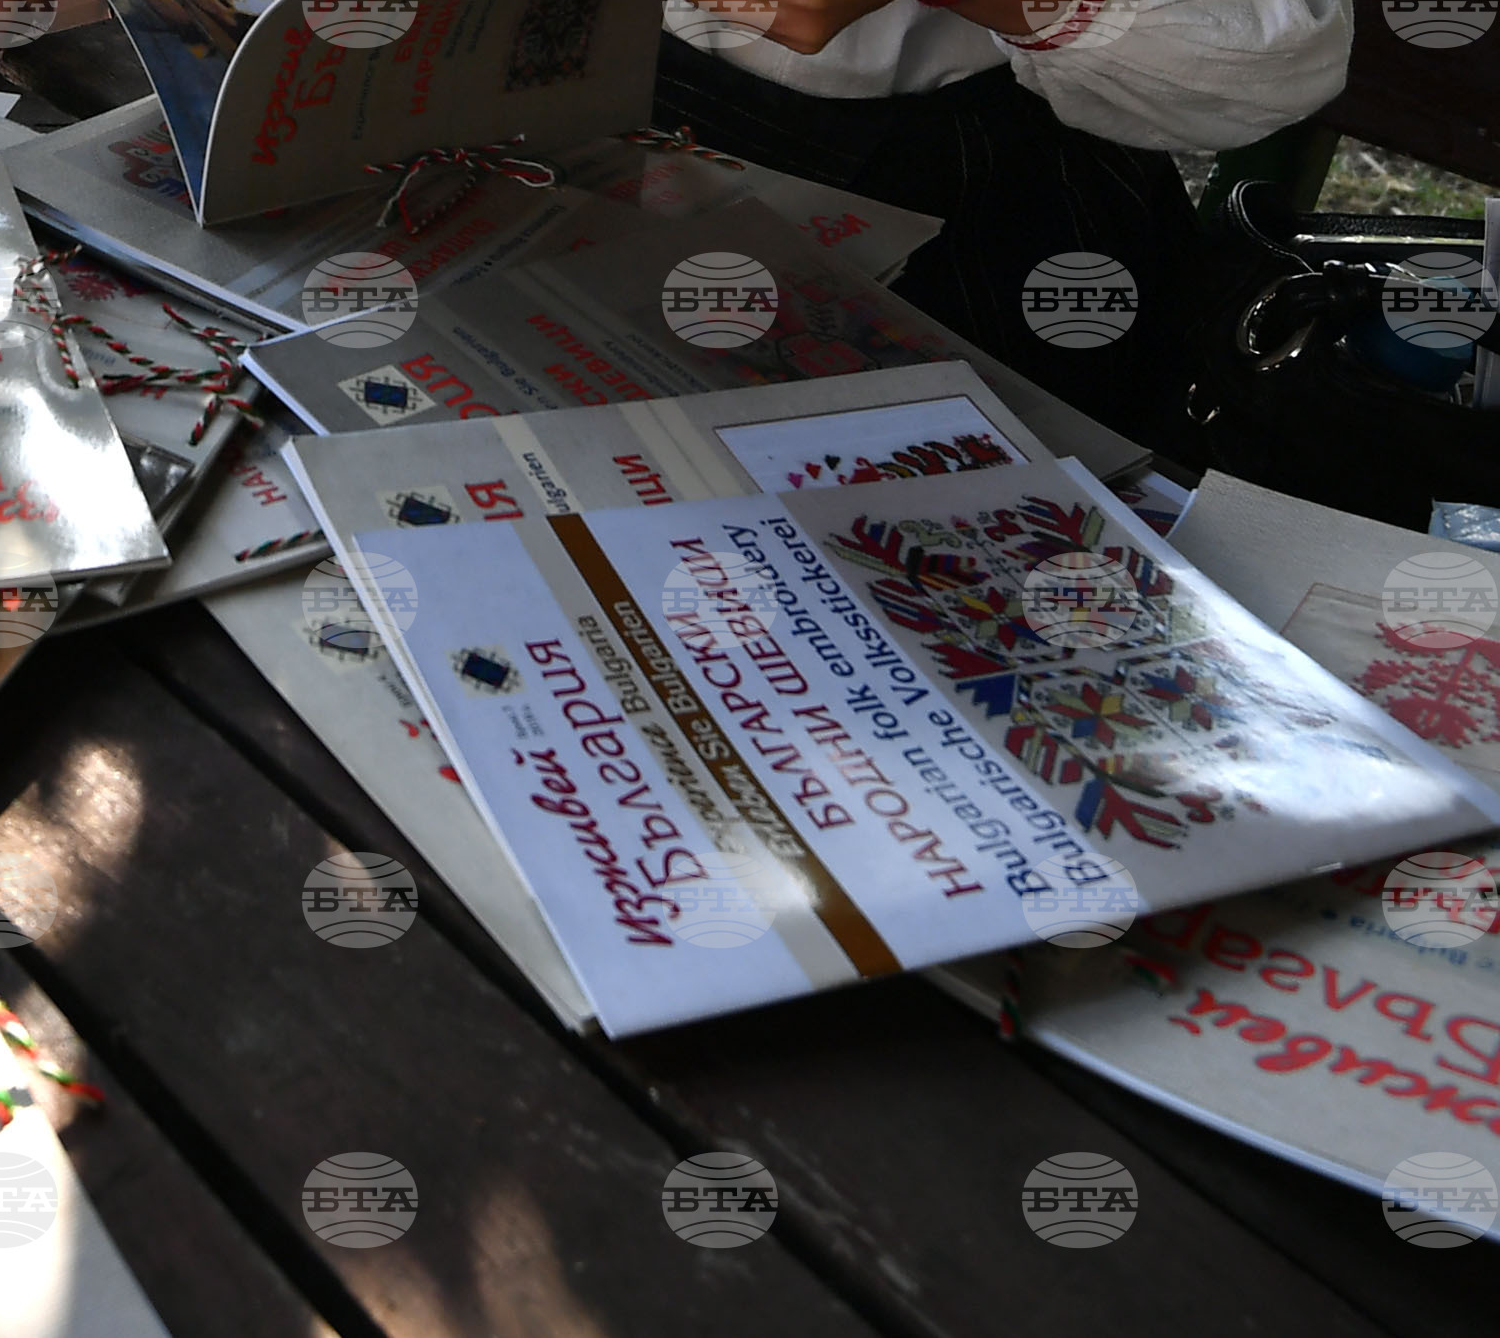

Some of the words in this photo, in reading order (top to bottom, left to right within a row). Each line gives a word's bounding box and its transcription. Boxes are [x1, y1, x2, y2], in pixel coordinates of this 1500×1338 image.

[521, 450, 572, 513] ulgarien
[577, 614, 651, 716] Bulgaria
[614, 600, 700, 715] Bulgarien
[669, 538, 809, 697] ШЕВИЦИ
[720, 521, 855, 679] embroidery
[757, 516, 931, 707] Volksstickerei
[524, 638, 710, 890] България
[663, 611, 854, 832] БЪЛГАРСКИ
[688, 718, 730, 762] Sie
[844, 683, 909, 742] folk
[511, 747, 680, 948] Изживей
[791, 702, 985, 900] НАРОДНИ
[902, 745, 1057, 899] Bulgarian
[927, 708, 1110, 888] Bulgarische
[1141, 904, 1500, 1088] Българ
[1168, 989, 1500, 1134] живей
